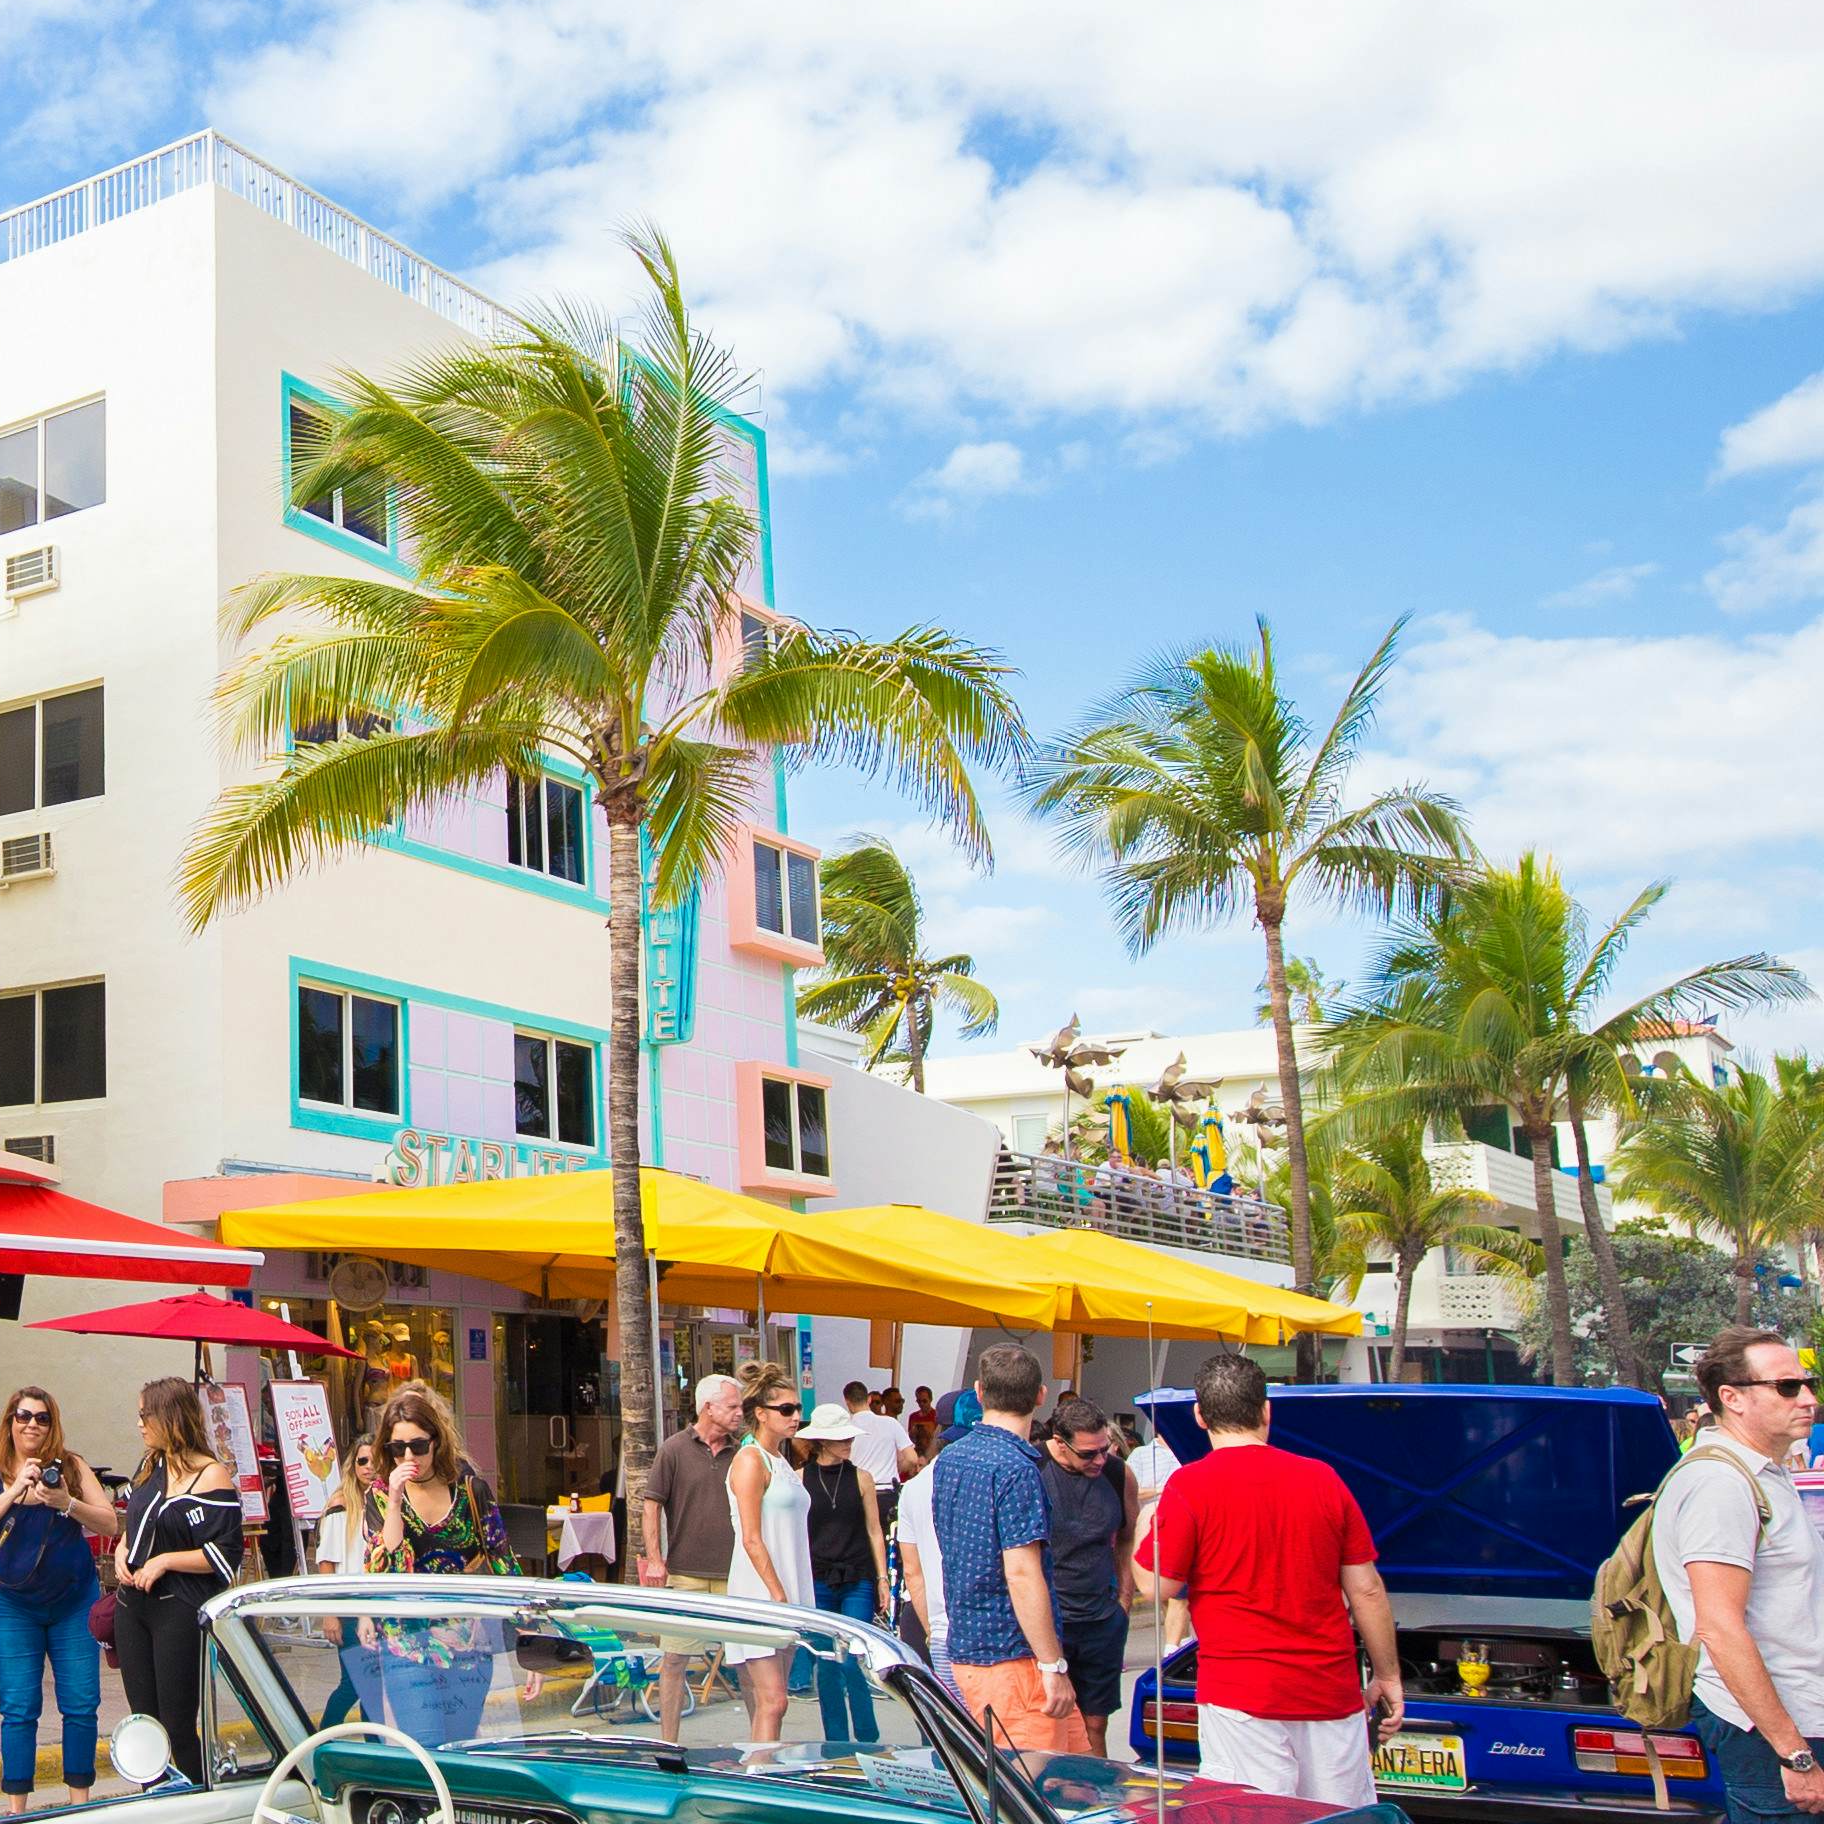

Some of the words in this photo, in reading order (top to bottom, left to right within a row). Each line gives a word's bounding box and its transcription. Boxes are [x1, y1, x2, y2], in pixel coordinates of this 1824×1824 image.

[303, 1404, 321, 1418] ALL
[289, 1420, 303, 1431] OFF
[1419, 1749, 1459, 1778] ERA
[1383, 1774, 1436, 1785] FLORIDA
